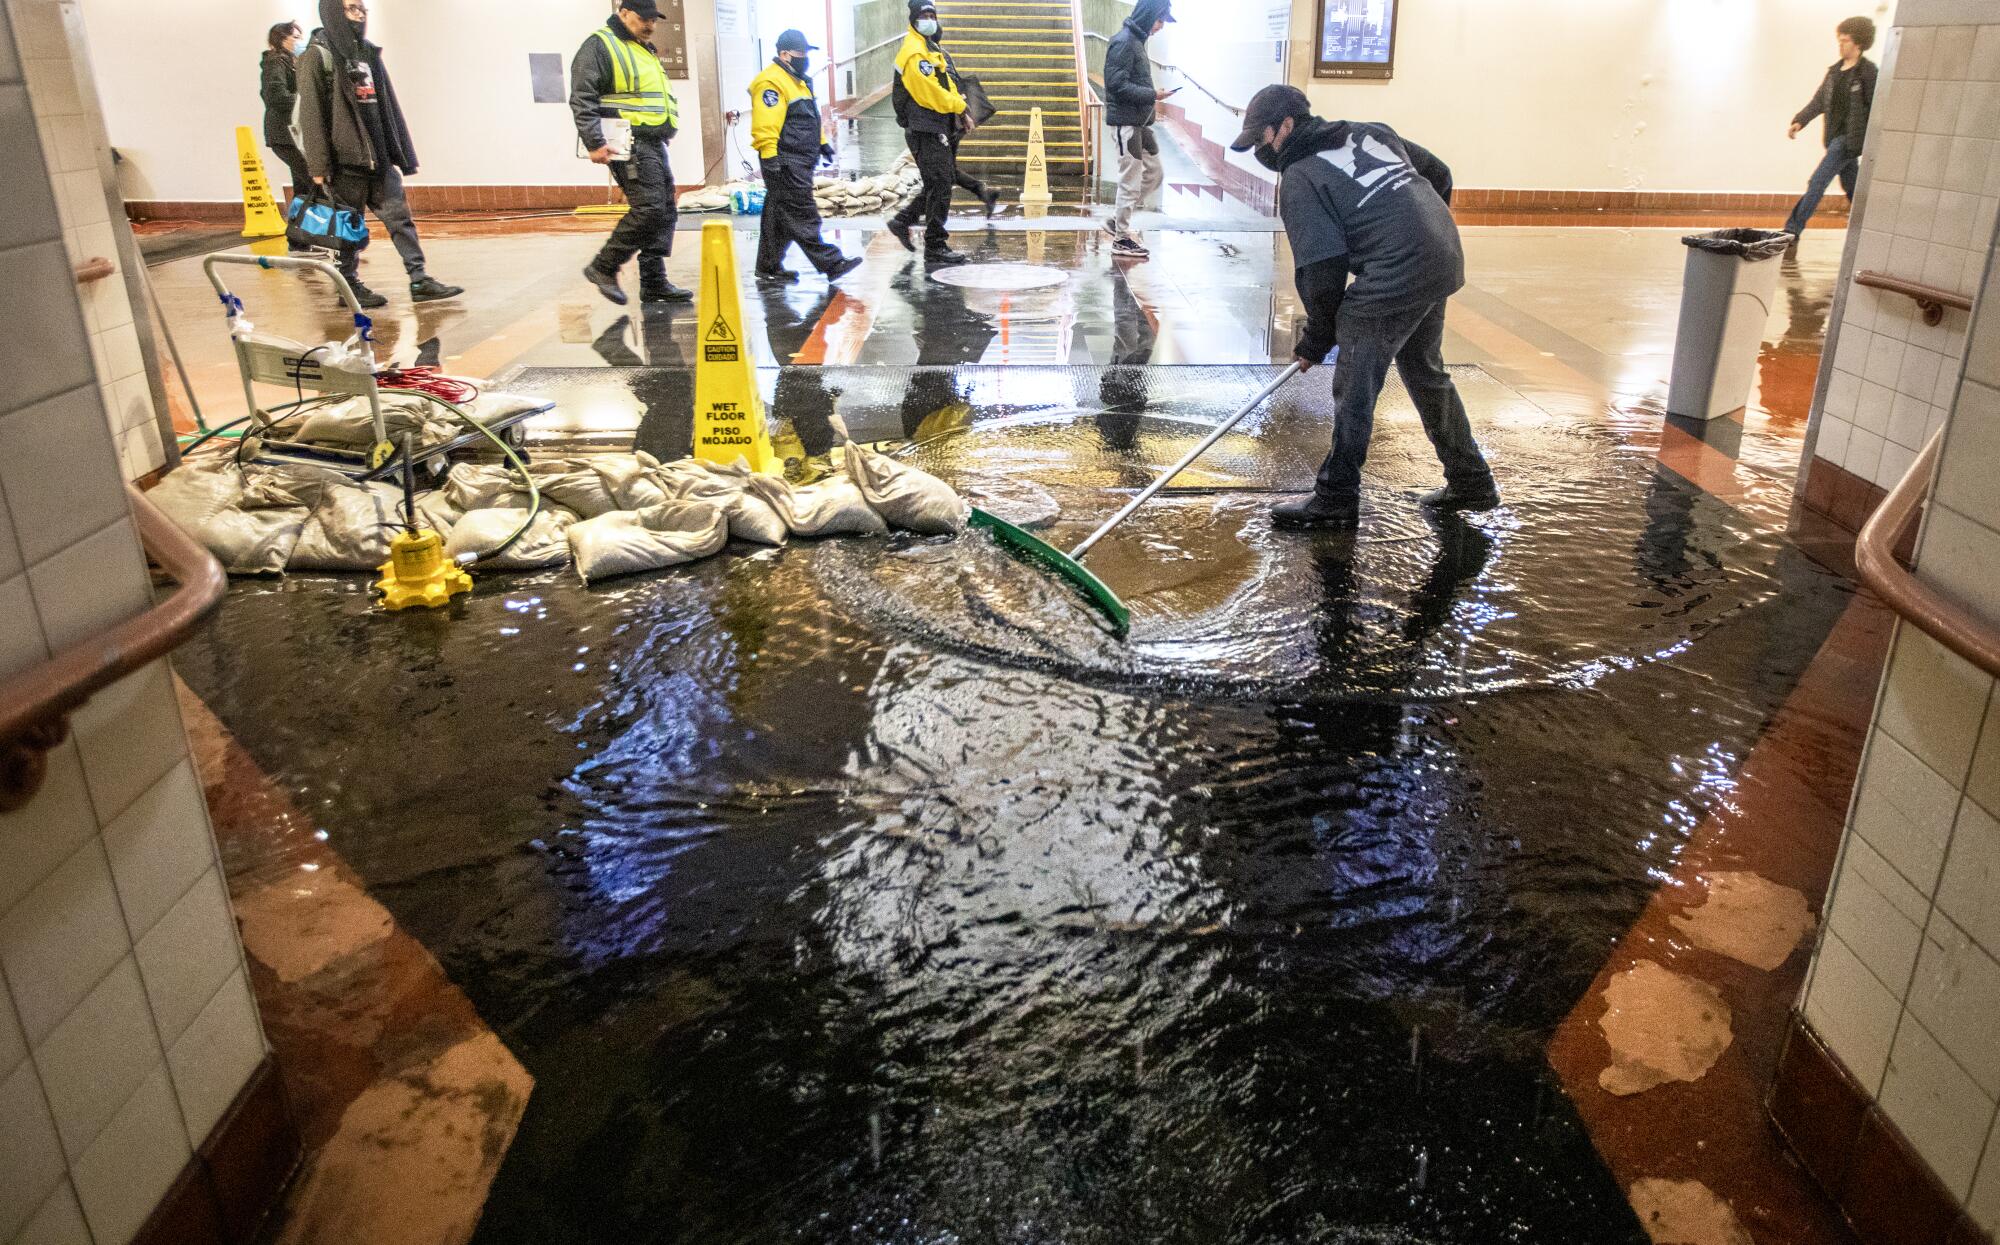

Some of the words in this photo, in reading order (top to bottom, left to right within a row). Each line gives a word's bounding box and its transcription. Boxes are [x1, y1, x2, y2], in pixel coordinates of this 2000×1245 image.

[707, 353, 736, 361] CUIDADO
[712, 402, 738, 411] WET
[706, 412, 745, 420] FLOOR
[713, 427, 740, 435] PISO
[702, 436, 752, 445] MOJADO
